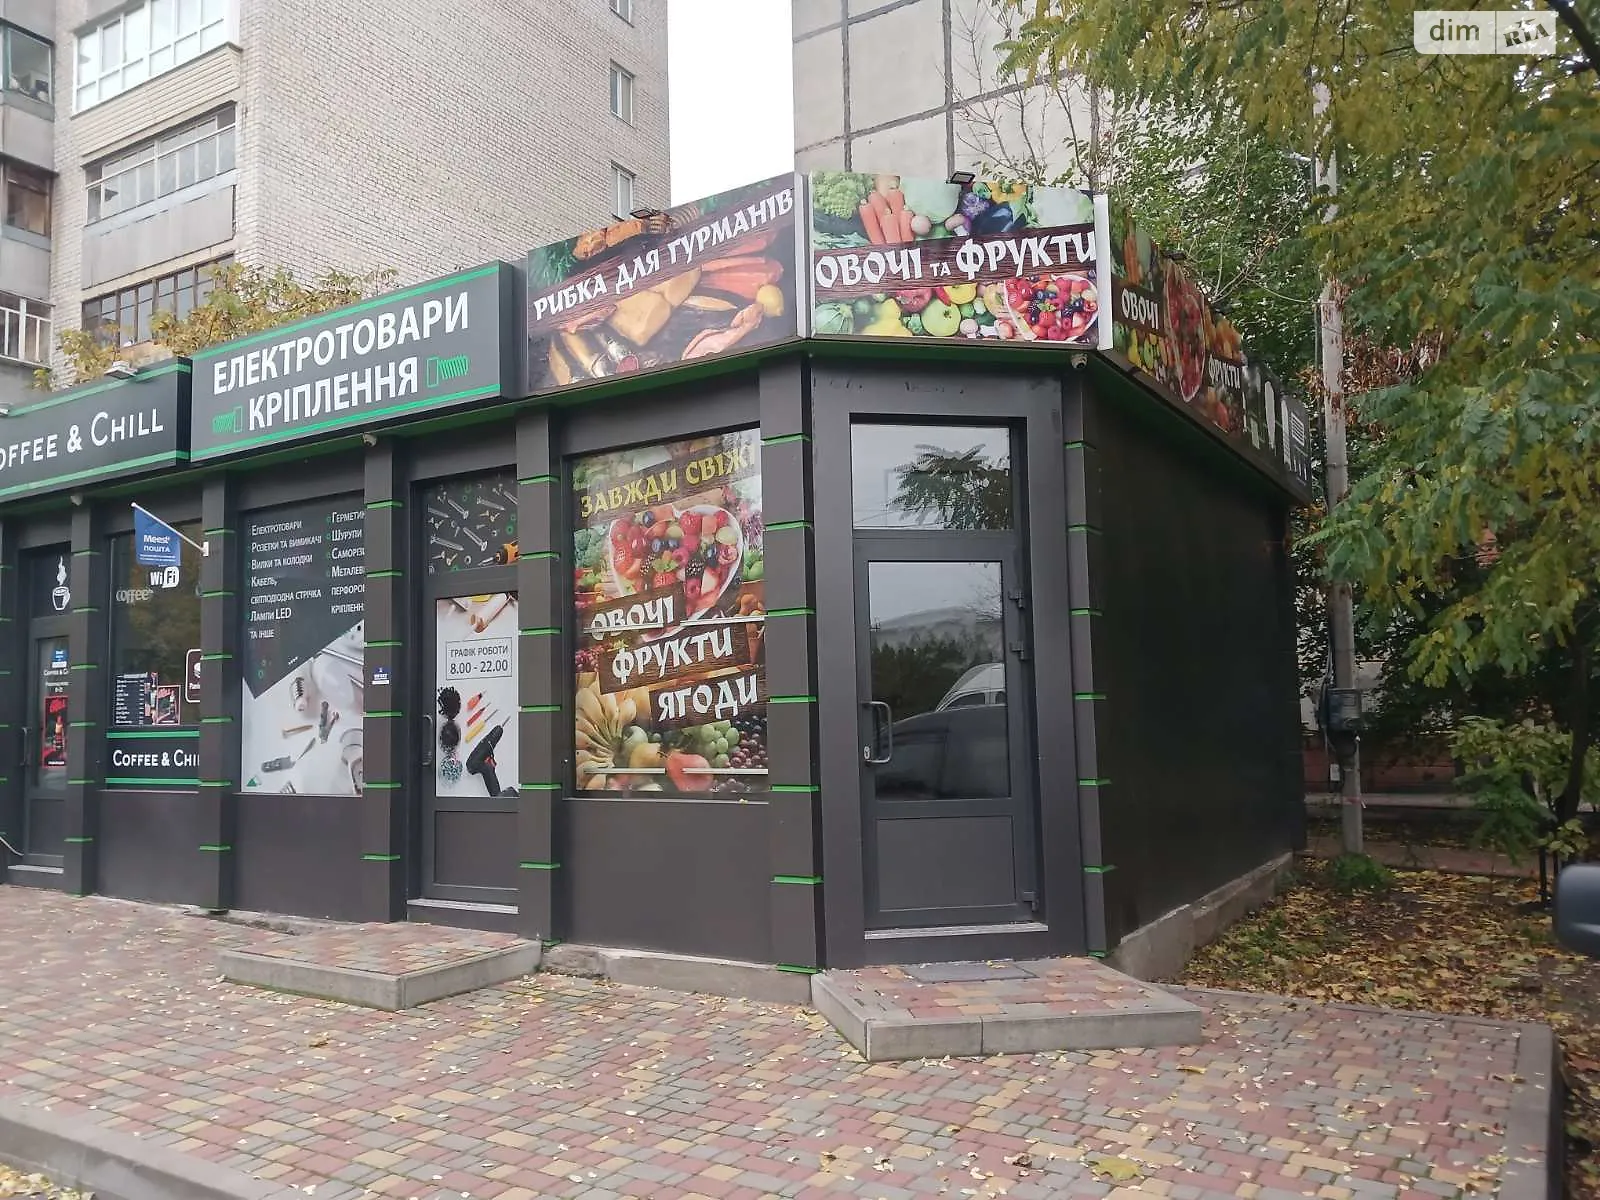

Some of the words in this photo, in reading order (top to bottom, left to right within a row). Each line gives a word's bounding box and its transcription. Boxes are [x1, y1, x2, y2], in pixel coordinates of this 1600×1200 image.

[533, 273, 608, 321] РИБКА
[615, 248, 660, 294] ДЛЯ
[667, 187, 793, 264] ГУРМАНІВ
[815, 248, 921, 288] ОВОЧІ
[930, 263, 951, 277] ТА
[956, 230, 1097, 281] ФРУКТИ
[1121, 287, 1159, 330] ОВОЧІ
[213, 291, 469, 395] ЕЛЕКТРОТОВАРИ
[249, 356, 418, 431] КРІПЛЕННЯ
[66, 424, 83, 453] &
[91, 408, 164, 447] CHILL
[580, 468, 677, 518] ЗАВЖДИ
[275, 607, 292, 620] LED
[591, 595, 674, 641] ОВОЧІ
[450, 647, 476, 658] ГРАФІК
[478, 644, 508, 656] РОБОТИ
[450, 662, 472, 675] 8.00
[480, 659, 508, 673] 22.00
[612, 627, 733, 685] ФРУКТИ
[658, 674, 758, 722] ЯГОДИ
[112, 749, 158, 767] COFFEE
[161, 751, 170, 767] &
[173, 748, 200, 767] CHI
